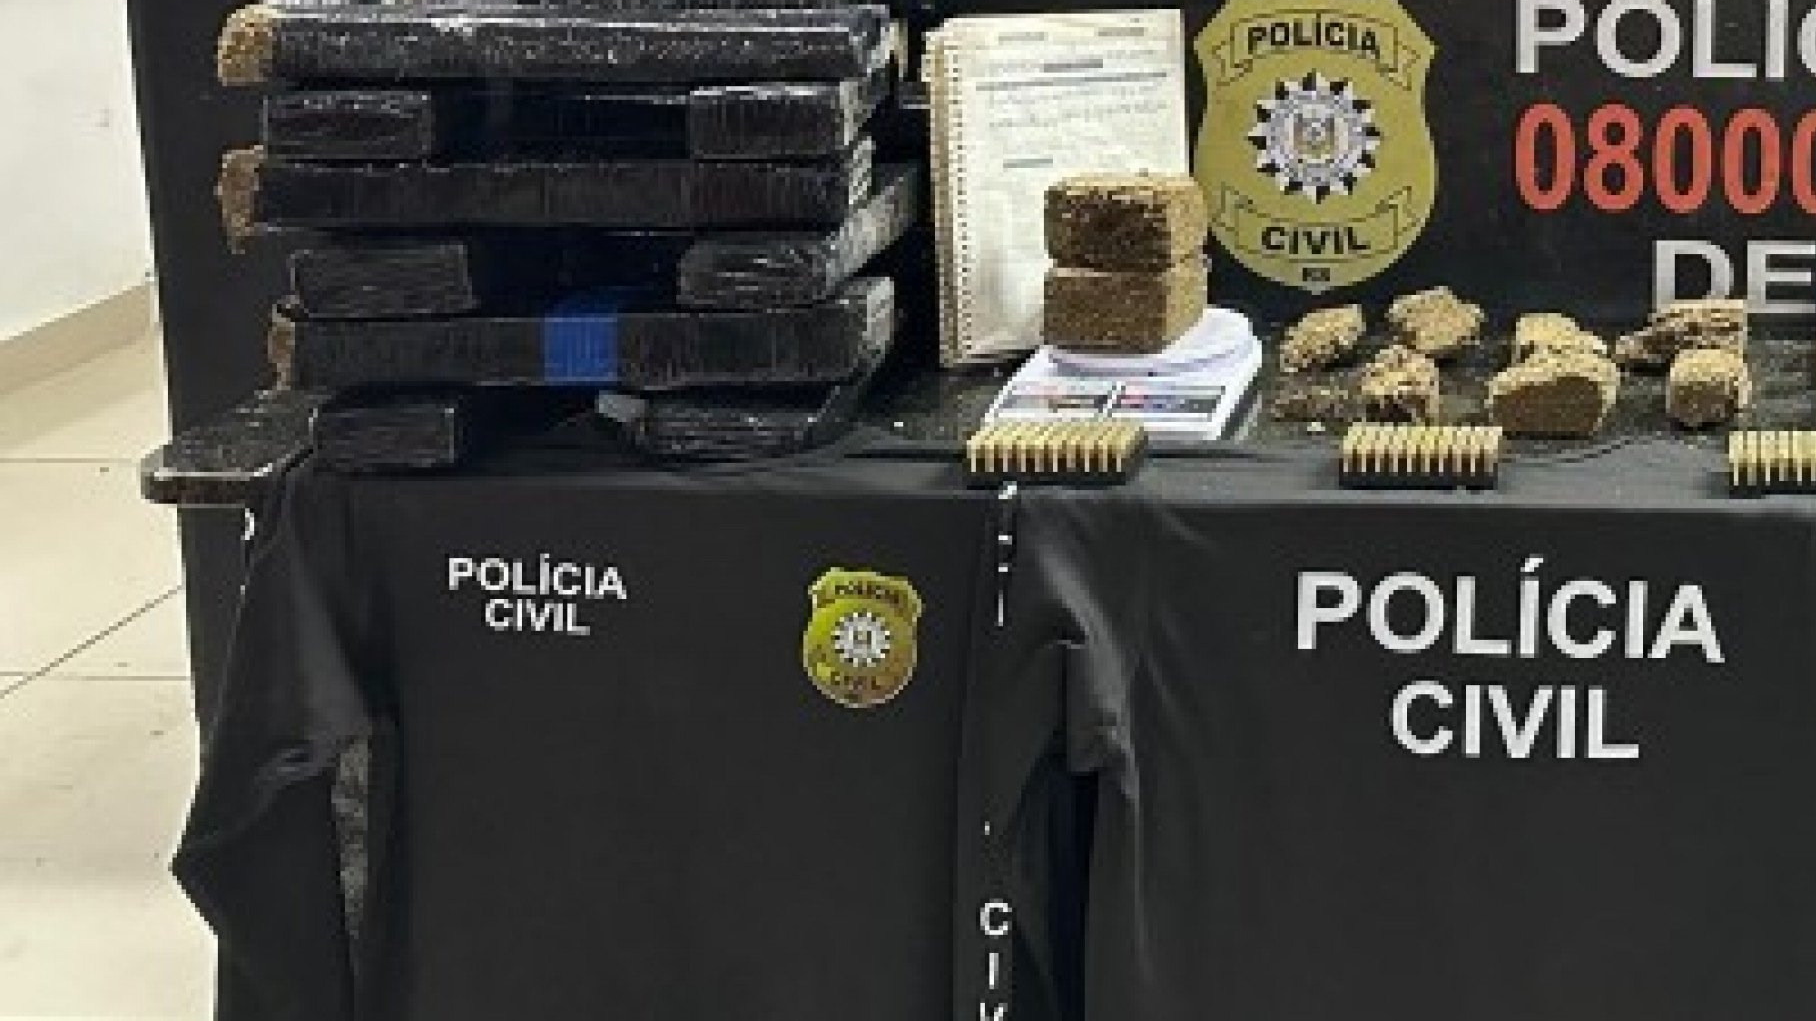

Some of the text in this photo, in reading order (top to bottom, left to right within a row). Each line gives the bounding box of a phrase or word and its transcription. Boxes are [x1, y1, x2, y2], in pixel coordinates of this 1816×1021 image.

[1261, 226, 1371, 255] CIVIL
[448, 553, 627, 600] POLÍCIA
[484, 598, 591, 636] CIVIL
[1297, 554, 1726, 664] POLÍCIA
[1390, 680, 1640, 759] CIVIL
